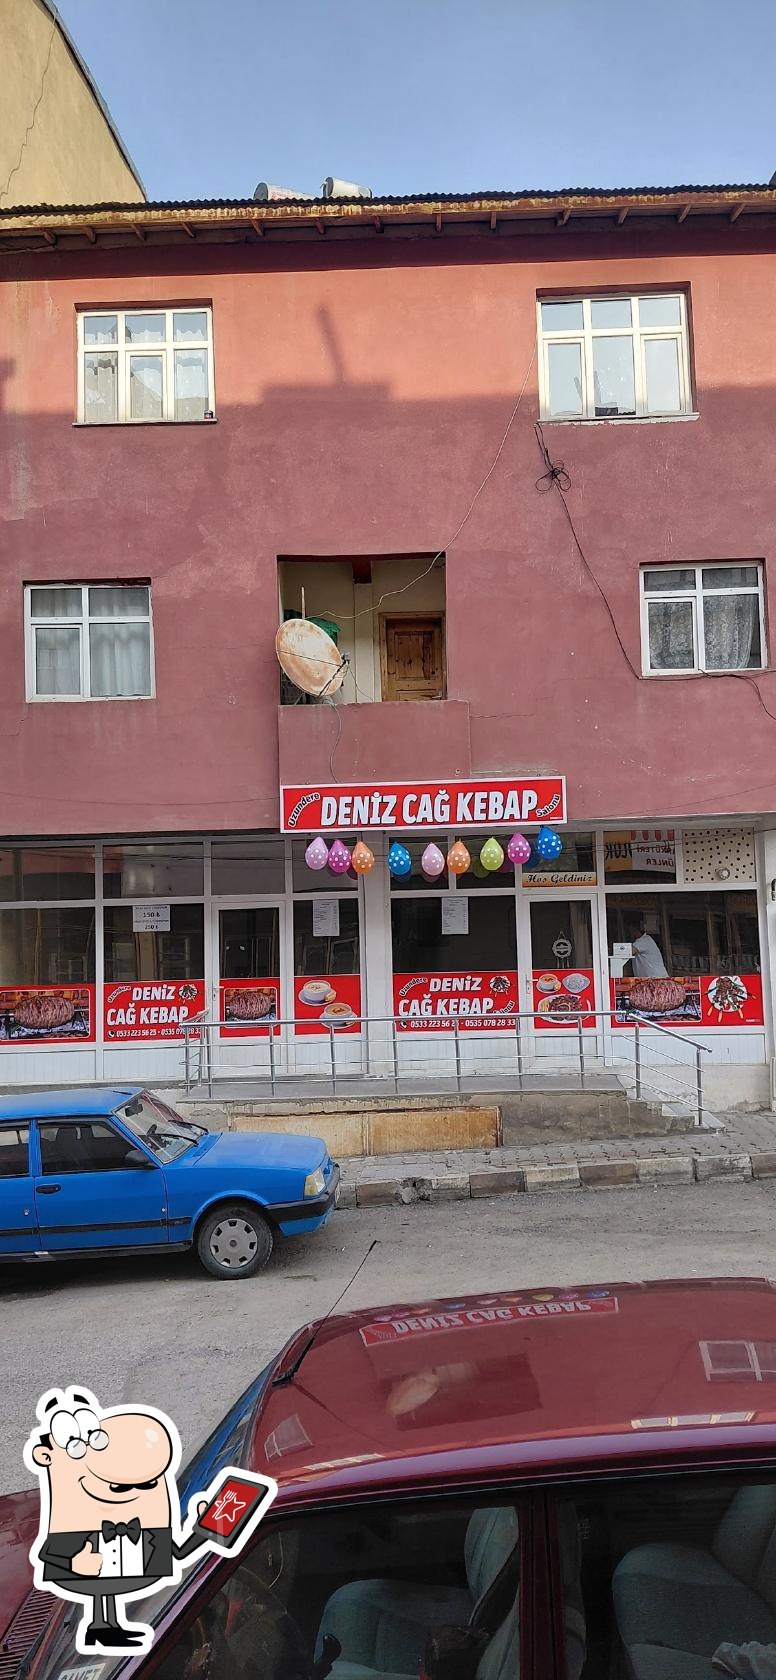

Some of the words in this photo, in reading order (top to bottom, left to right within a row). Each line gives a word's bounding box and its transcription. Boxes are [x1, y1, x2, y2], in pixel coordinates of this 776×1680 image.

[288, 792, 320, 828] Uzundere
[320, 791, 397, 826] DENİZ
[402, 789, 450, 824] CAĞ
[456, 789, 538, 821] KEBAP
[536, 794, 560, 817] Salonu
[550, 873, 593, 884] Geldiniz
[106, 1002, 137, 1026] CAĞ
[140, 1006, 189, 1025] KEBAP
[398, 994, 433, 1017] CAĞ
[436, 997, 494, 1016] KEBAP
[131, 1029, 141, 1037] 223
[410, 1020, 427, 1028] 0533
[428, 1020, 441, 1028] 223
[441, 1020, 450, 1028] 56
[465, 1019, 482, 1027] 0535
[483, 1018, 496, 1027] 078
[497, 1018, 506, 1027] 28
[507, 1018, 516, 1027] 33
